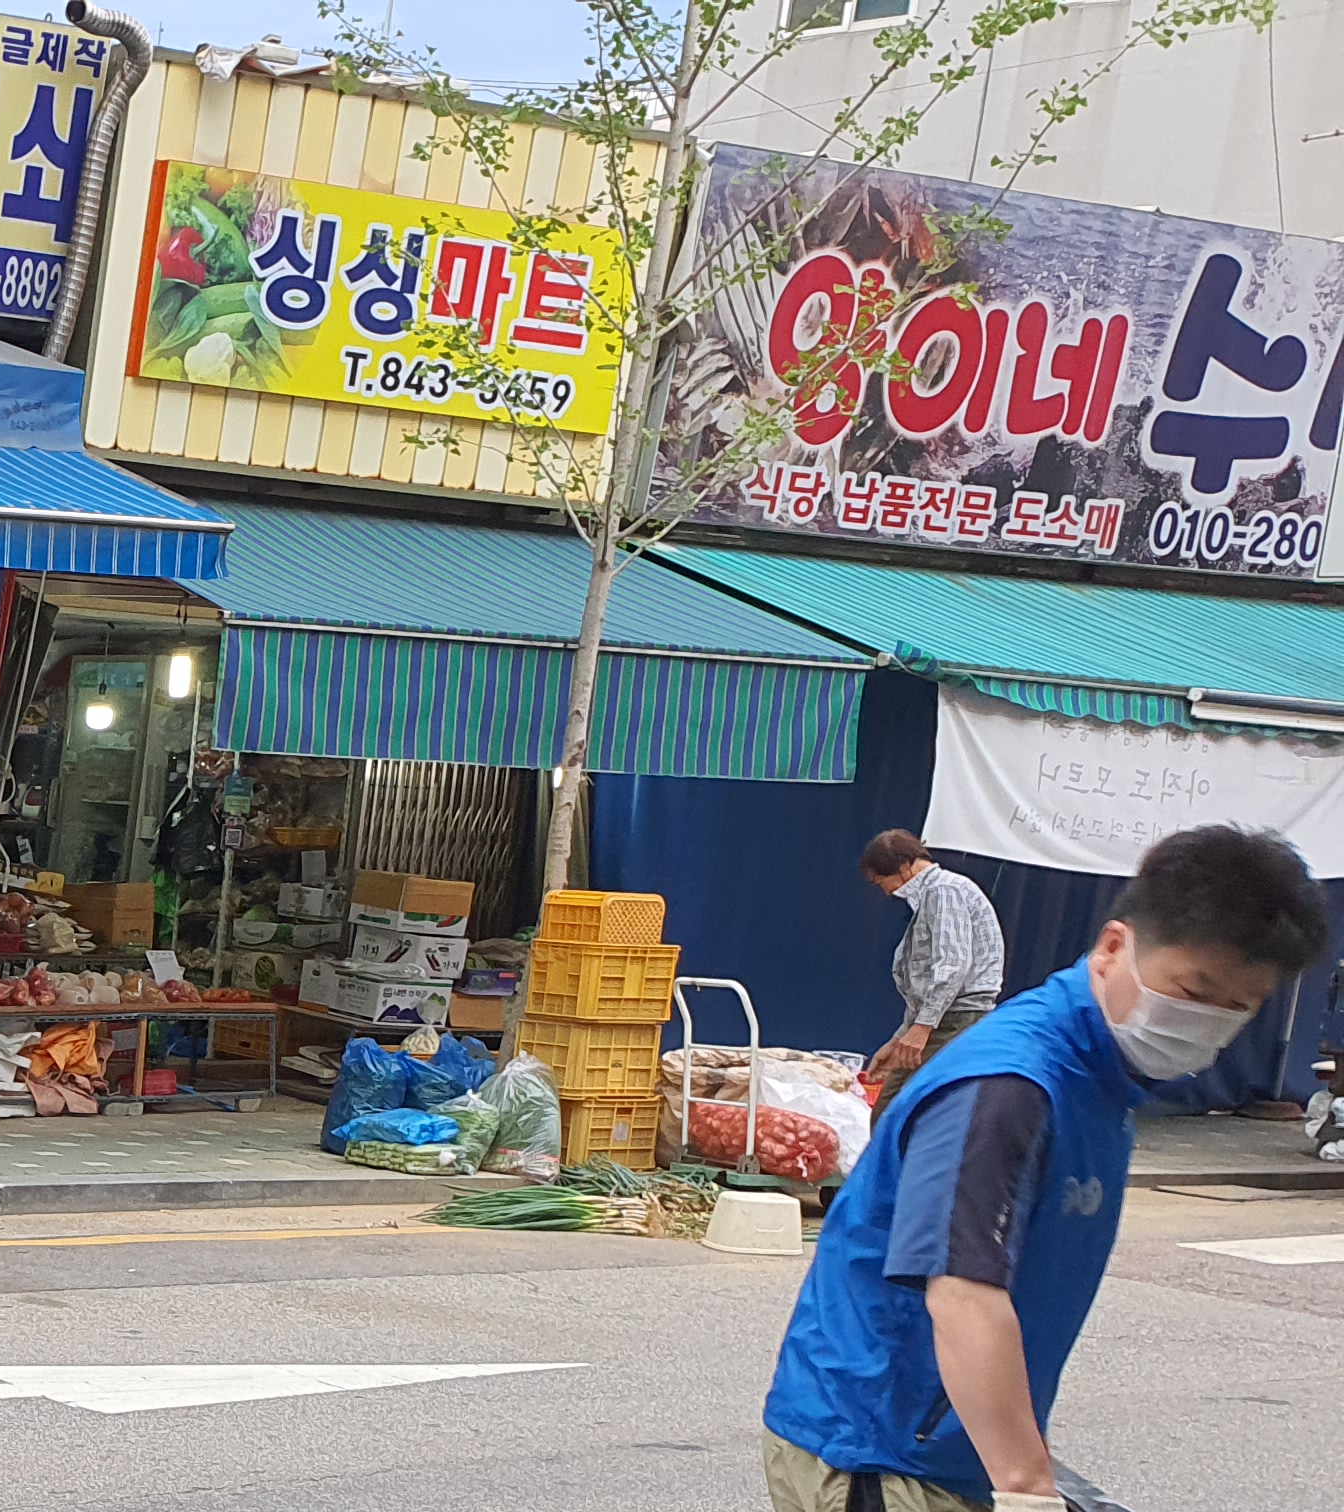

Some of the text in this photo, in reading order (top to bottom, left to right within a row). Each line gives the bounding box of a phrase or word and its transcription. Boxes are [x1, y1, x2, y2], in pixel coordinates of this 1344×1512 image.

[253, 214, 591, 348] 싱싱마트
[1151, 253, 1344, 494] 수
[746, 465, 1120, 553] 식당 납품전문 도소매
